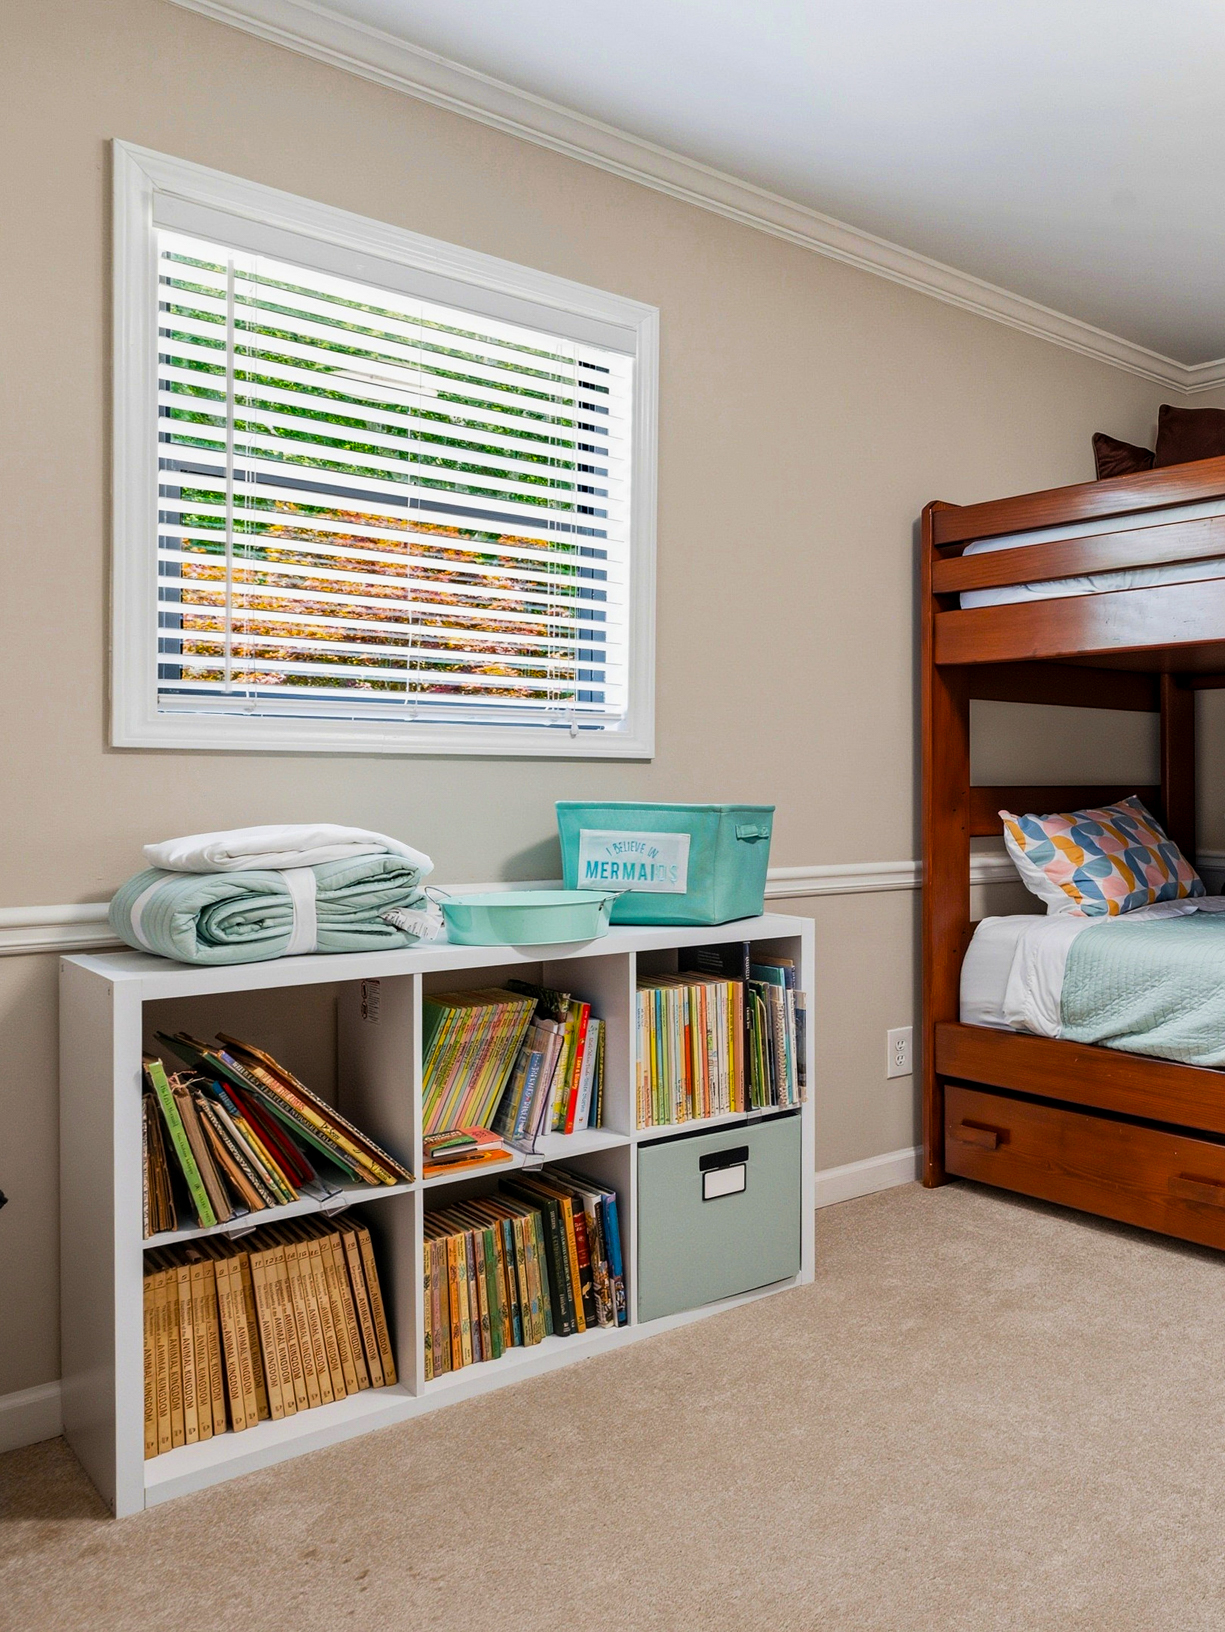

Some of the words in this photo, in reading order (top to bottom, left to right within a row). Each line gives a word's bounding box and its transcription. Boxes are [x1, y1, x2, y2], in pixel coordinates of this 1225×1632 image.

[606, 847, 612, 856] I
[612, 841, 646, 854] BELIEVE
[647, 846, 659, 859] IN
[321, 1306, 332, 1335] ANIMAL
[331, 1300, 342, 1329] ANIMAL
[344, 1298, 355, 1326] ANIMAL
[371, 1293, 382, 1319] ANIMAL
[262, 1321, 273, 1350] ANIMAL
[275, 1317, 285, 1347] ANIMAL
[297, 1311, 308, 1340] ANIMAL
[309, 1309, 320, 1337] ANIMAL
[359, 1298, 369, 1325] ANIMAL
[364, 1325, 377, 1361] KINGDOM
[376, 1320, 389, 1356] KINGDOM
[169, 1338, 178, 1369] ANIMAL
[182, 1338, 191, 1369] ANIMAL
[196, 1334, 206, 1366] ANIMAL
[209, 1331, 218, 1362] ANIMAL
[224, 1330, 235, 1361] ANIMAL
[238, 1326, 247, 1356] ANIMAL
[285, 1314, 295, 1343] ANIMAL
[290, 1343, 301, 1380] KINGDOM
[314, 1337, 326, 1375] KINGDOM
[349, 1325, 362, 1361] KINGDOM
[157, 1344, 166, 1376] ANIMAL
[265, 1350, 278, 1388] KINGDOM
[279, 1347, 291, 1385] KINGDOM
[302, 1340, 314, 1377] KINGDOM
[170, 1371, 180, 1411] KINGDOM
[184, 1369, 194, 1410] KINGDOM
[198, 1367, 208, 1407] KINGDOM
[211, 1363, 221, 1401] KINGDOM
[227, 1361, 239, 1400] KINGDOM
[241, 1357, 252, 1396] KINGDOM
[158, 1377, 168, 1418] KINGDOM
